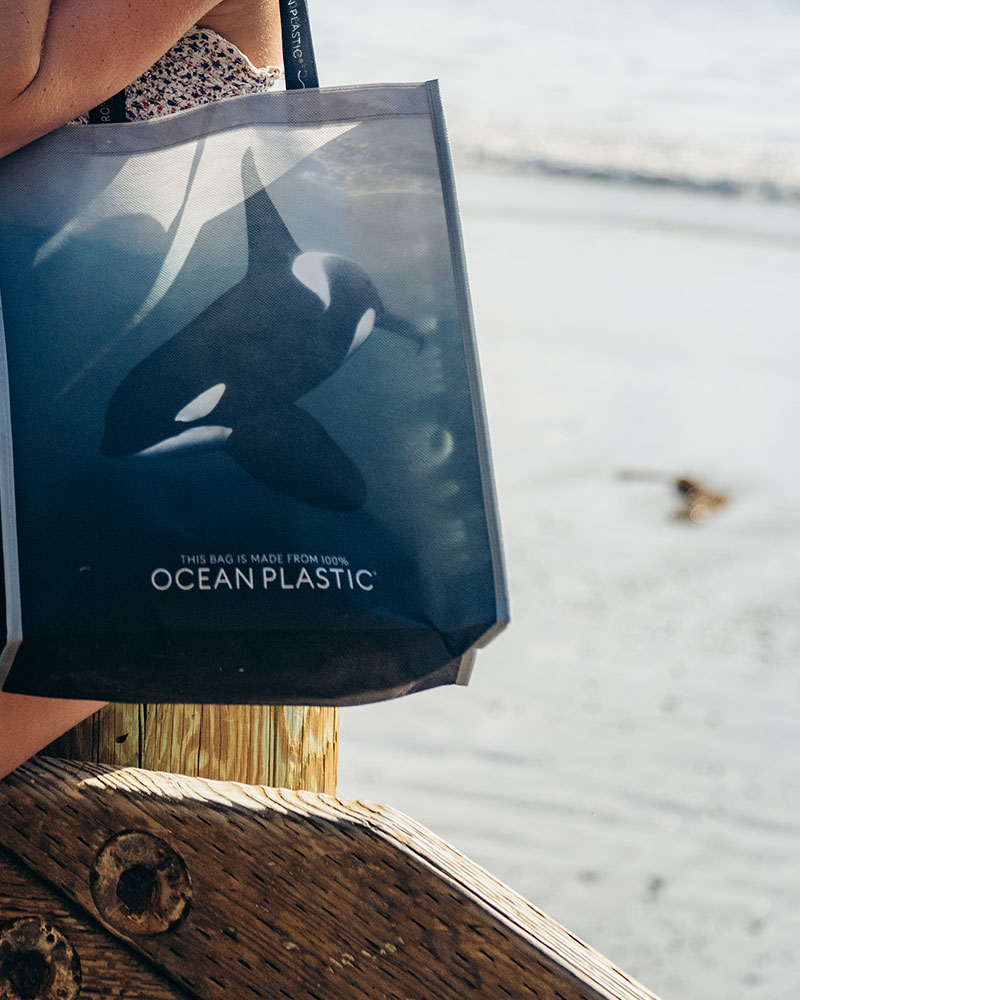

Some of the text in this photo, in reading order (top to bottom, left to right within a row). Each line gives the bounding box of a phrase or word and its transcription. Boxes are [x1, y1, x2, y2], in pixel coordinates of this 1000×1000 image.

[180, 553, 350, 567] THIS BAG IS MADE FROM 100%
[150, 567, 254, 591] OCEAN
